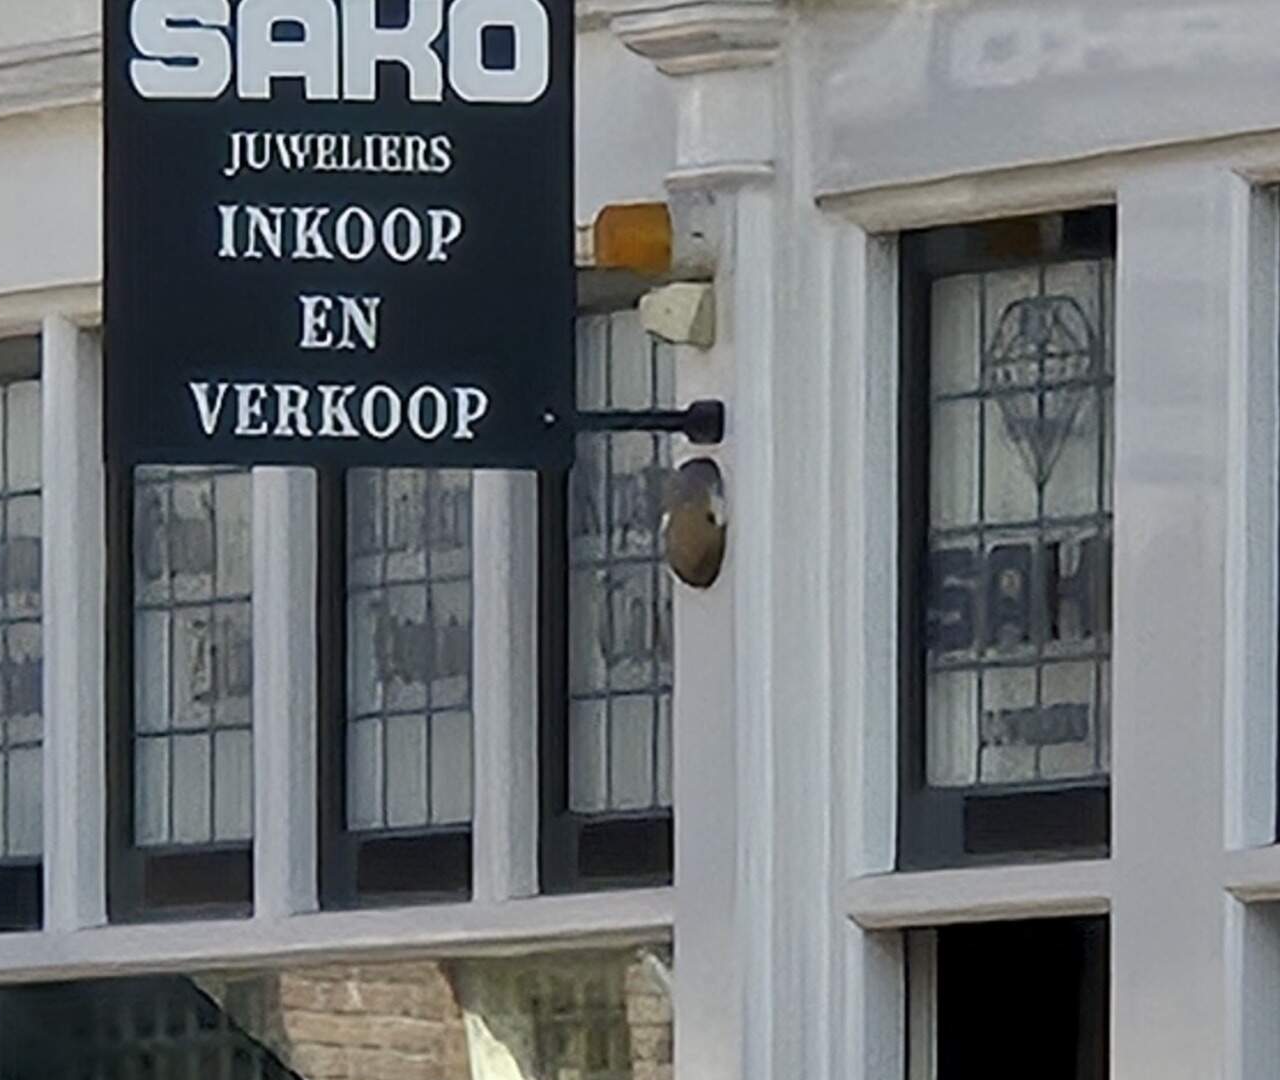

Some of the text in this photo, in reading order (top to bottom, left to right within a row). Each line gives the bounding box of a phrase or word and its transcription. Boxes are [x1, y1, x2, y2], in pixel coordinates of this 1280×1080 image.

[130, 0, 550, 102] SAKO
[223, 131, 452, 176] JUWELIERS
[217, 204, 462, 262] INKOOP
[298, 295, 381, 350] EN
[190, 381, 489, 440] VERKOOP
